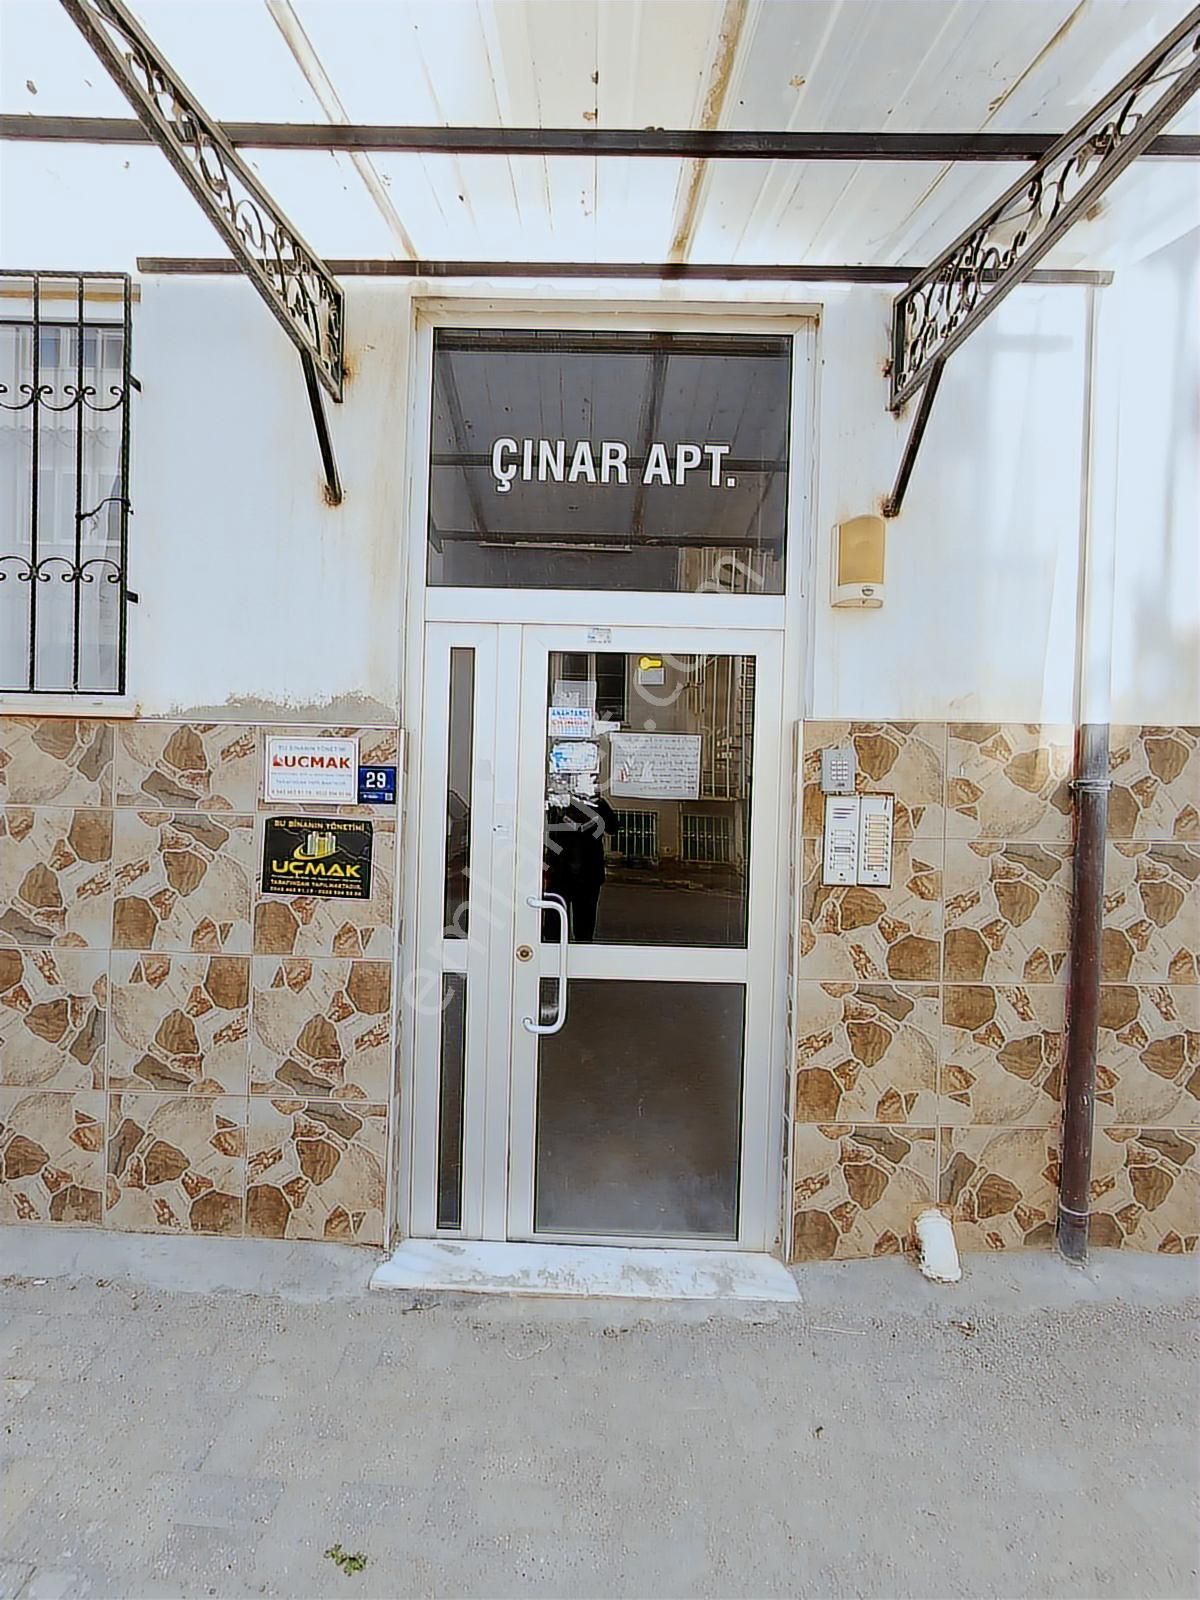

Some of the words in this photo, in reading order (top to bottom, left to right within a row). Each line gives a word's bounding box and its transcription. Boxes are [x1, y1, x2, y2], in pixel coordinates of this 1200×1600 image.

[491, 436, 629, 493] ÇINAR
[642, 441, 737, 488] APT.
[366, 771, 386, 788] 29
[274, 819, 286, 827] BU
[271, 860, 361, 878] UÇMAK
